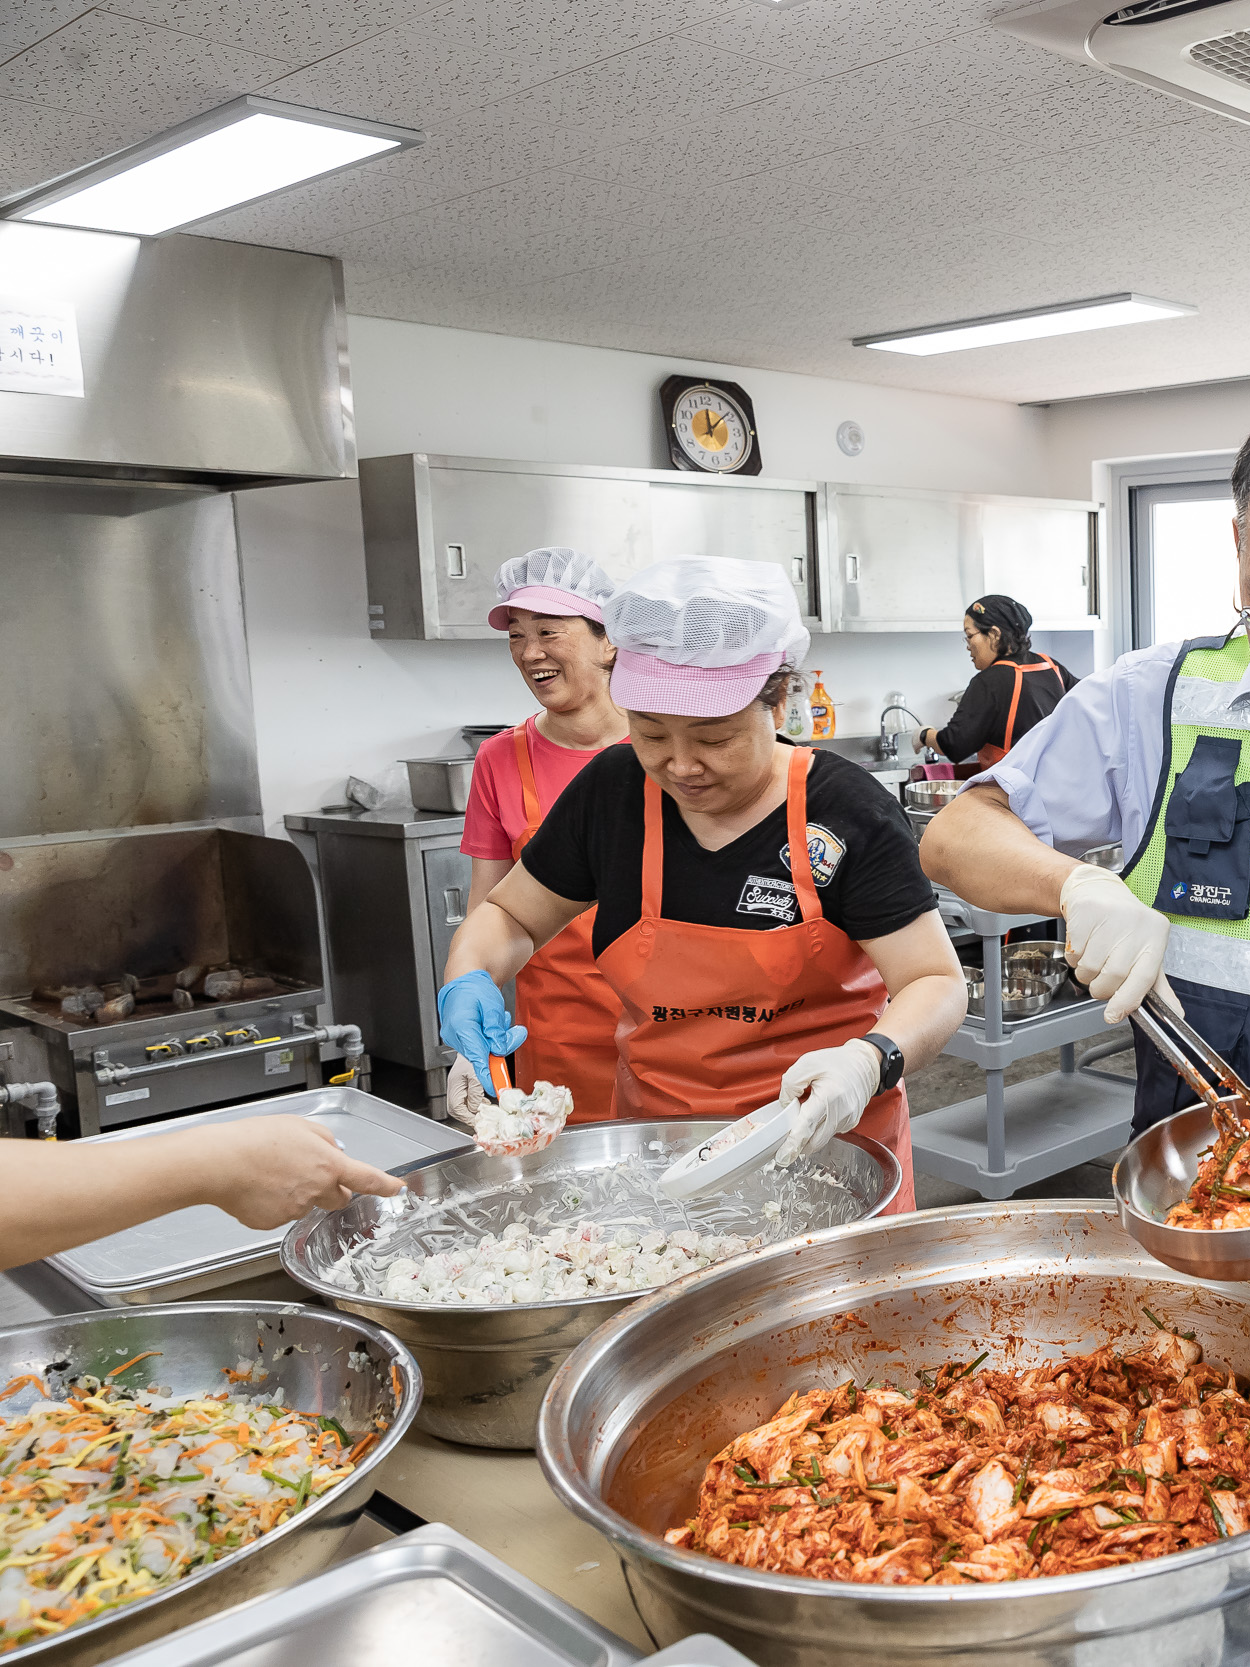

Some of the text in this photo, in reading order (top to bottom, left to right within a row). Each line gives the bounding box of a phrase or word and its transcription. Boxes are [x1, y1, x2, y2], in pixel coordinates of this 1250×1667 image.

[10, 324, 63, 344] 깨끗이
[689, 399, 698, 409] 11
[699, 395, 712, 406] 12
[681, 410, 693, 420] 10
[727, 413, 735, 422] 2
[680, 423, 688, 433] 9
[733, 428, 741, 438] 3
[687, 439, 695, 448] 8
[732, 441, 739, 451] 4
[698, 450, 706, 461] 7
[711, 456, 720, 465] 6
[724, 452, 732, 462] 5
[1191, 883, 1232, 899] 광진구
[651, 998, 806, 1024] 광진구자원봉사센터
